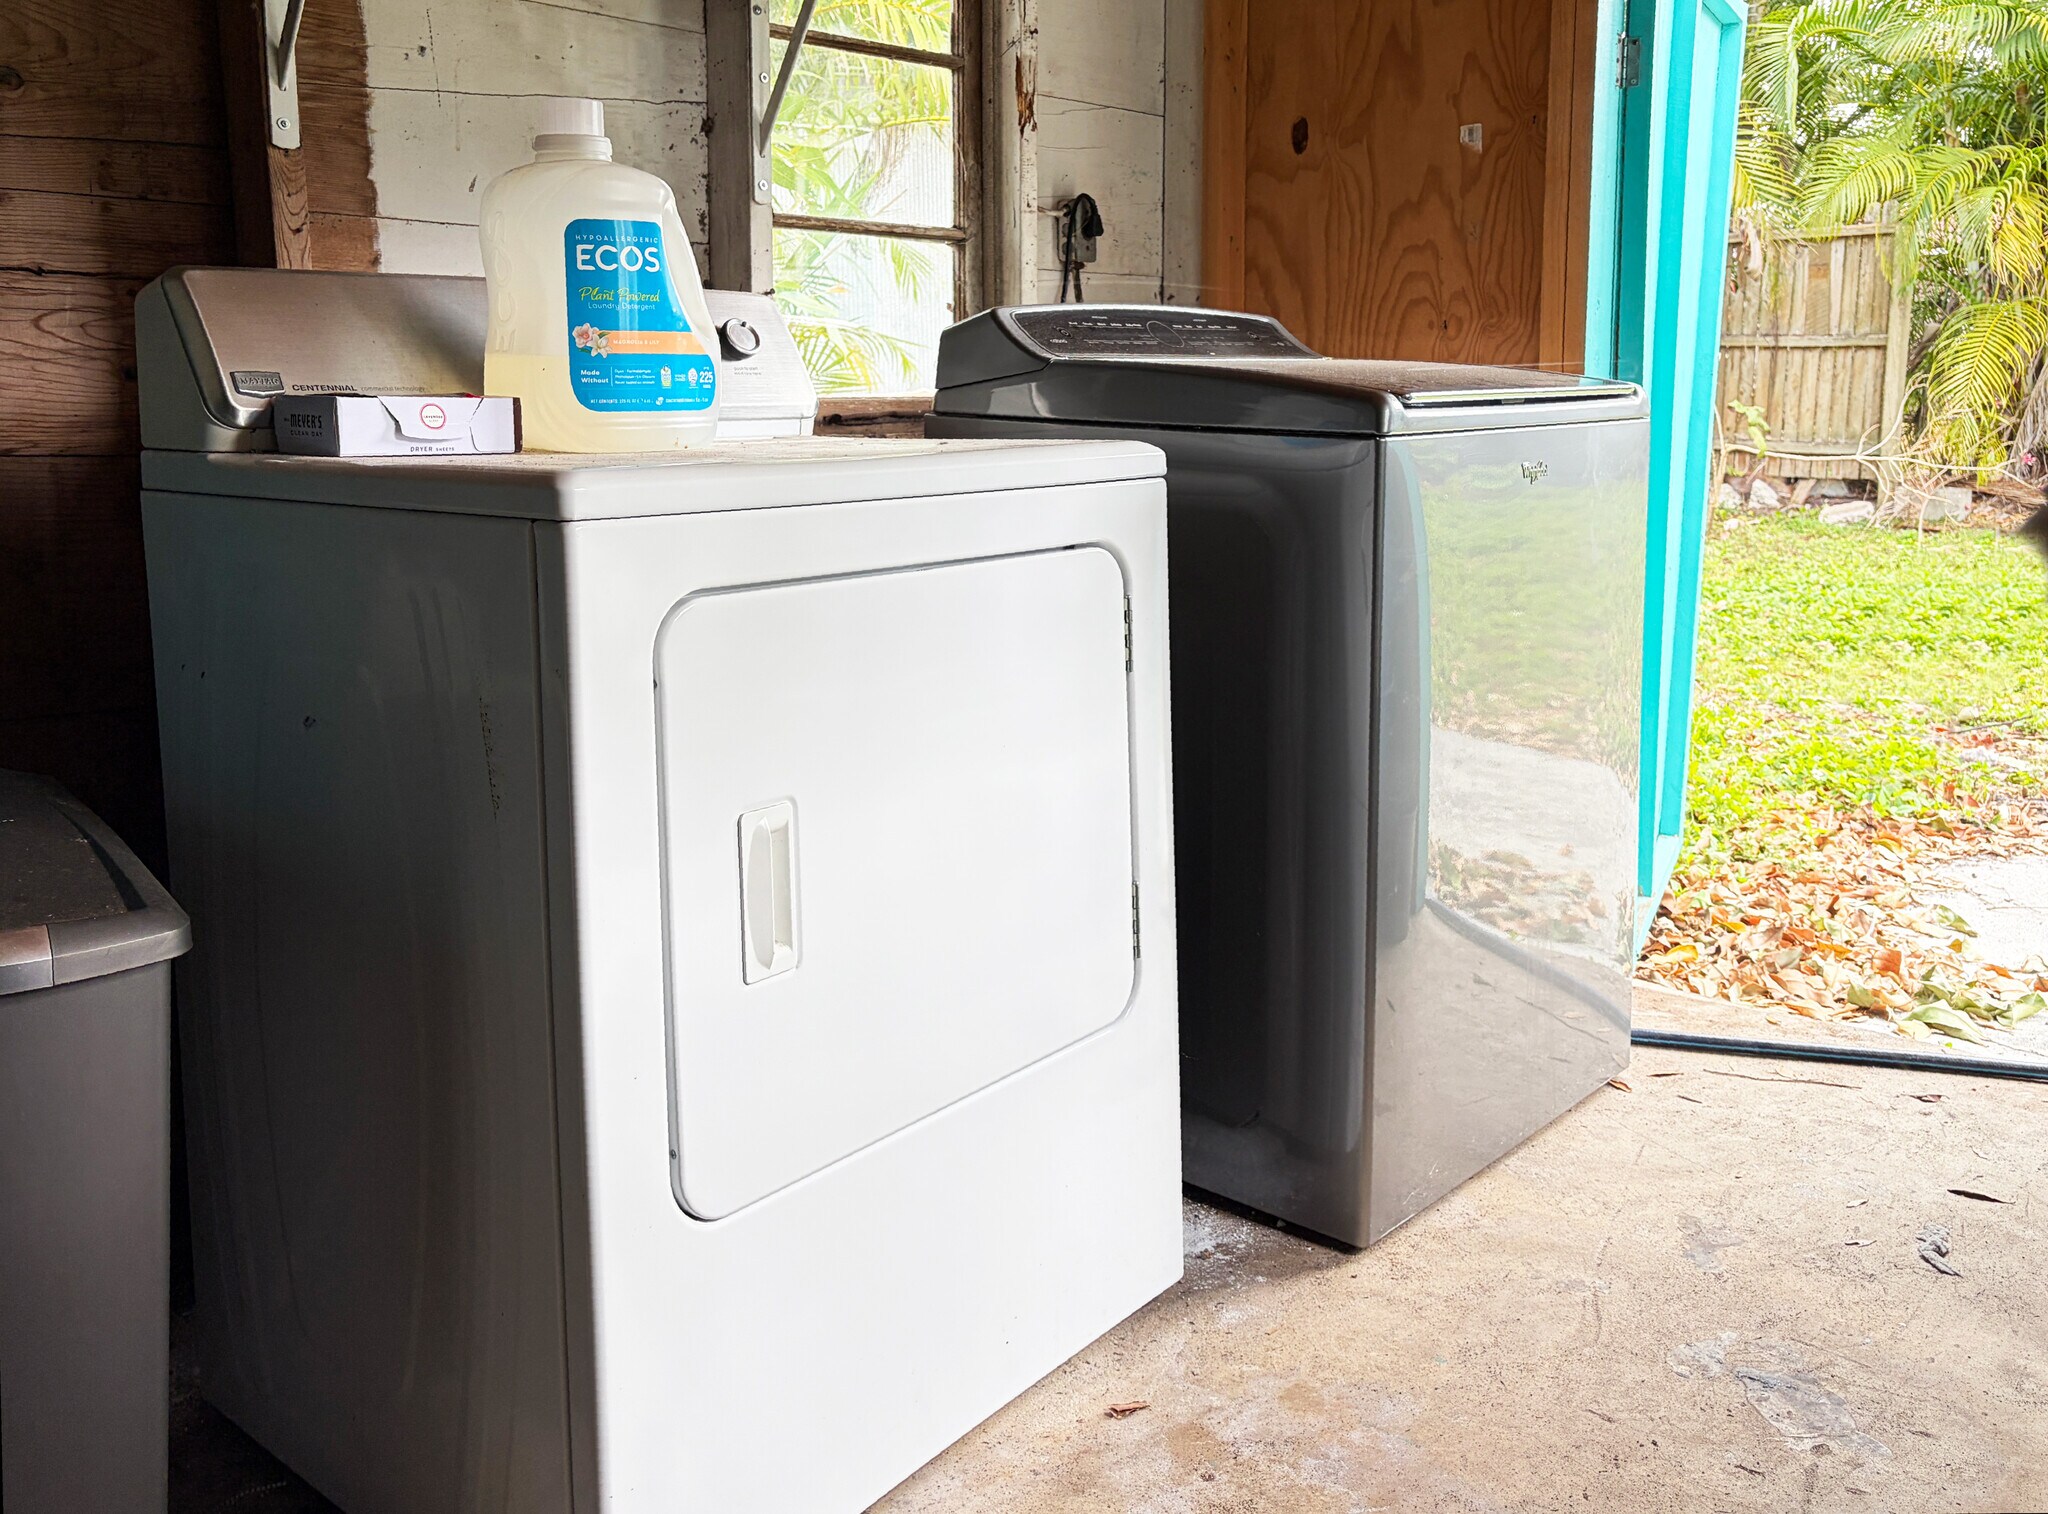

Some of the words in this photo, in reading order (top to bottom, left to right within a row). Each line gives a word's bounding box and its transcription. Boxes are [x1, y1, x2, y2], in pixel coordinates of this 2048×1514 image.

[575, 234, 658, 243] HYPOALLERGENIC
[576, 244, 660, 273] ECOS
[487, 210, 518, 352] ECOS
[578, 286, 614, 301] Plant
[617, 287, 660, 302] Powered
[587, 302, 620, 311] Laundry
[621, 302, 656, 311] Detergent
[239, 377, 280, 386] MAYTAG
[700, 371, 714, 383] 225
[292, 384, 358, 392] CENTENNIAL
[394, 385, 425, 393] technology
[290, 413, 323, 429] MEYER'S
